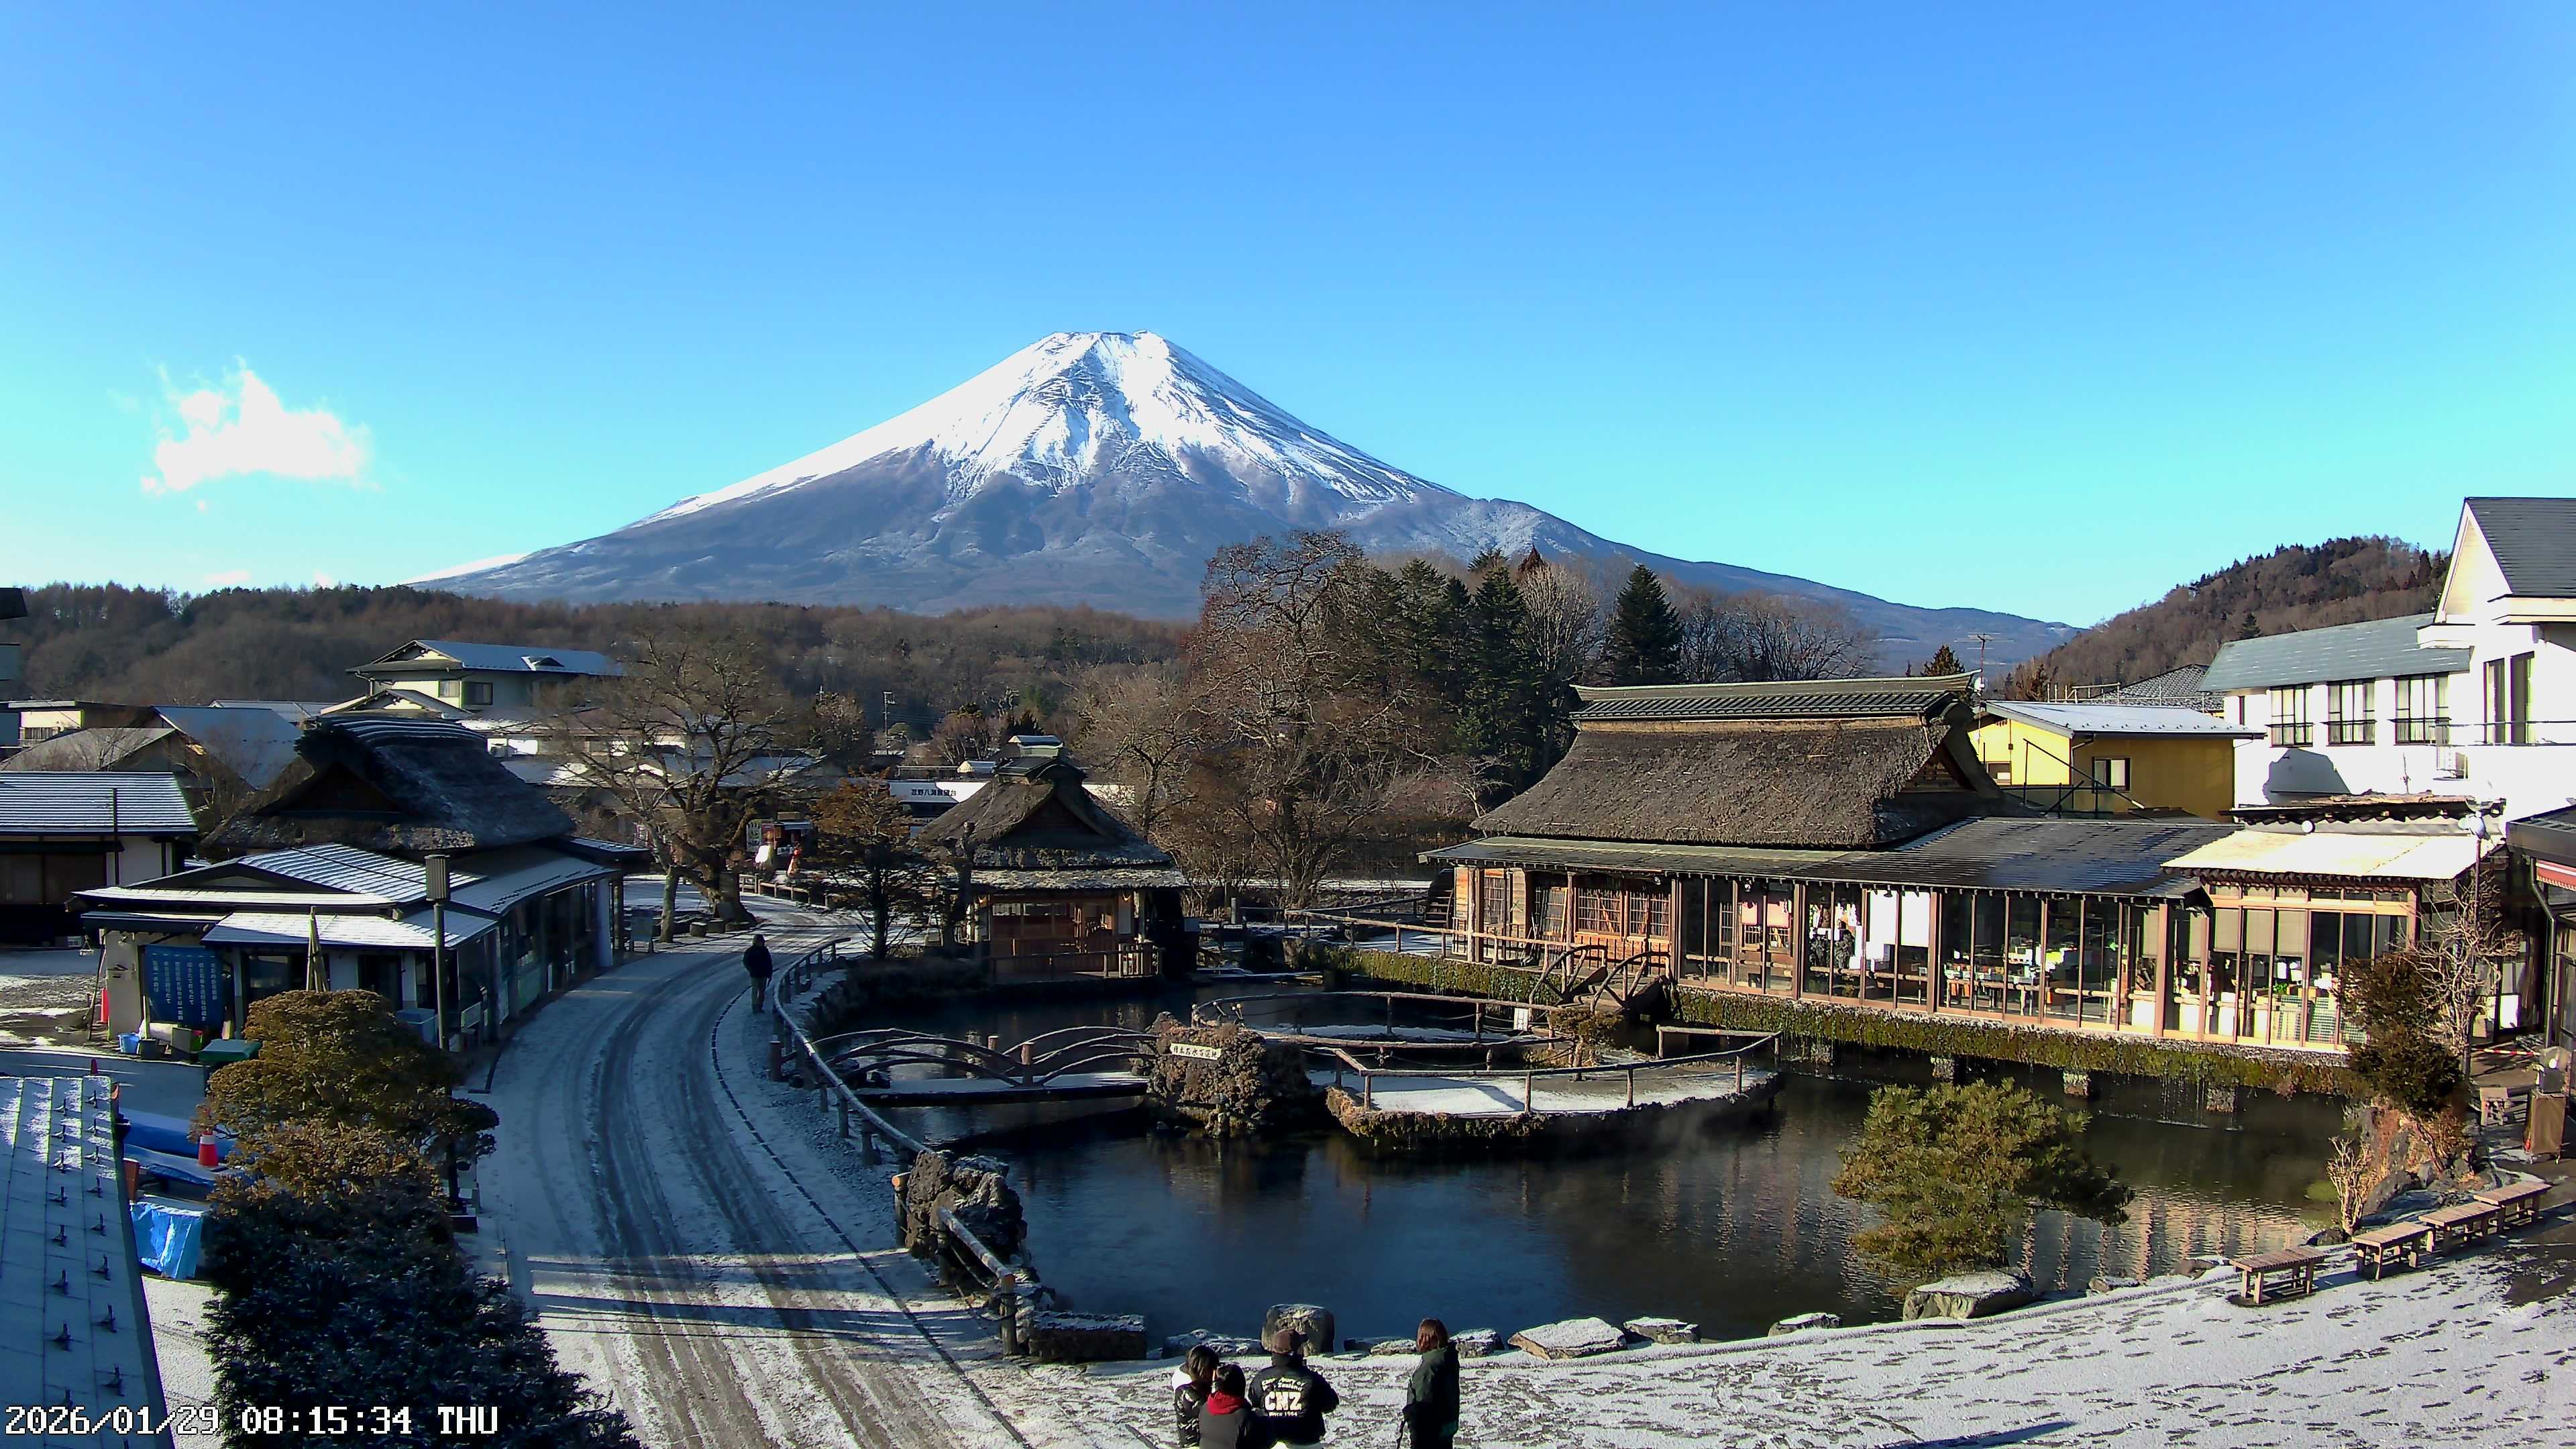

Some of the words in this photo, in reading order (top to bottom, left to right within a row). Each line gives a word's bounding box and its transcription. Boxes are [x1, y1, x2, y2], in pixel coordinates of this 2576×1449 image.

[911, 788, 957, 796] 忍野八海展望台
[1265, 1391, 1302, 1411] CNZ
